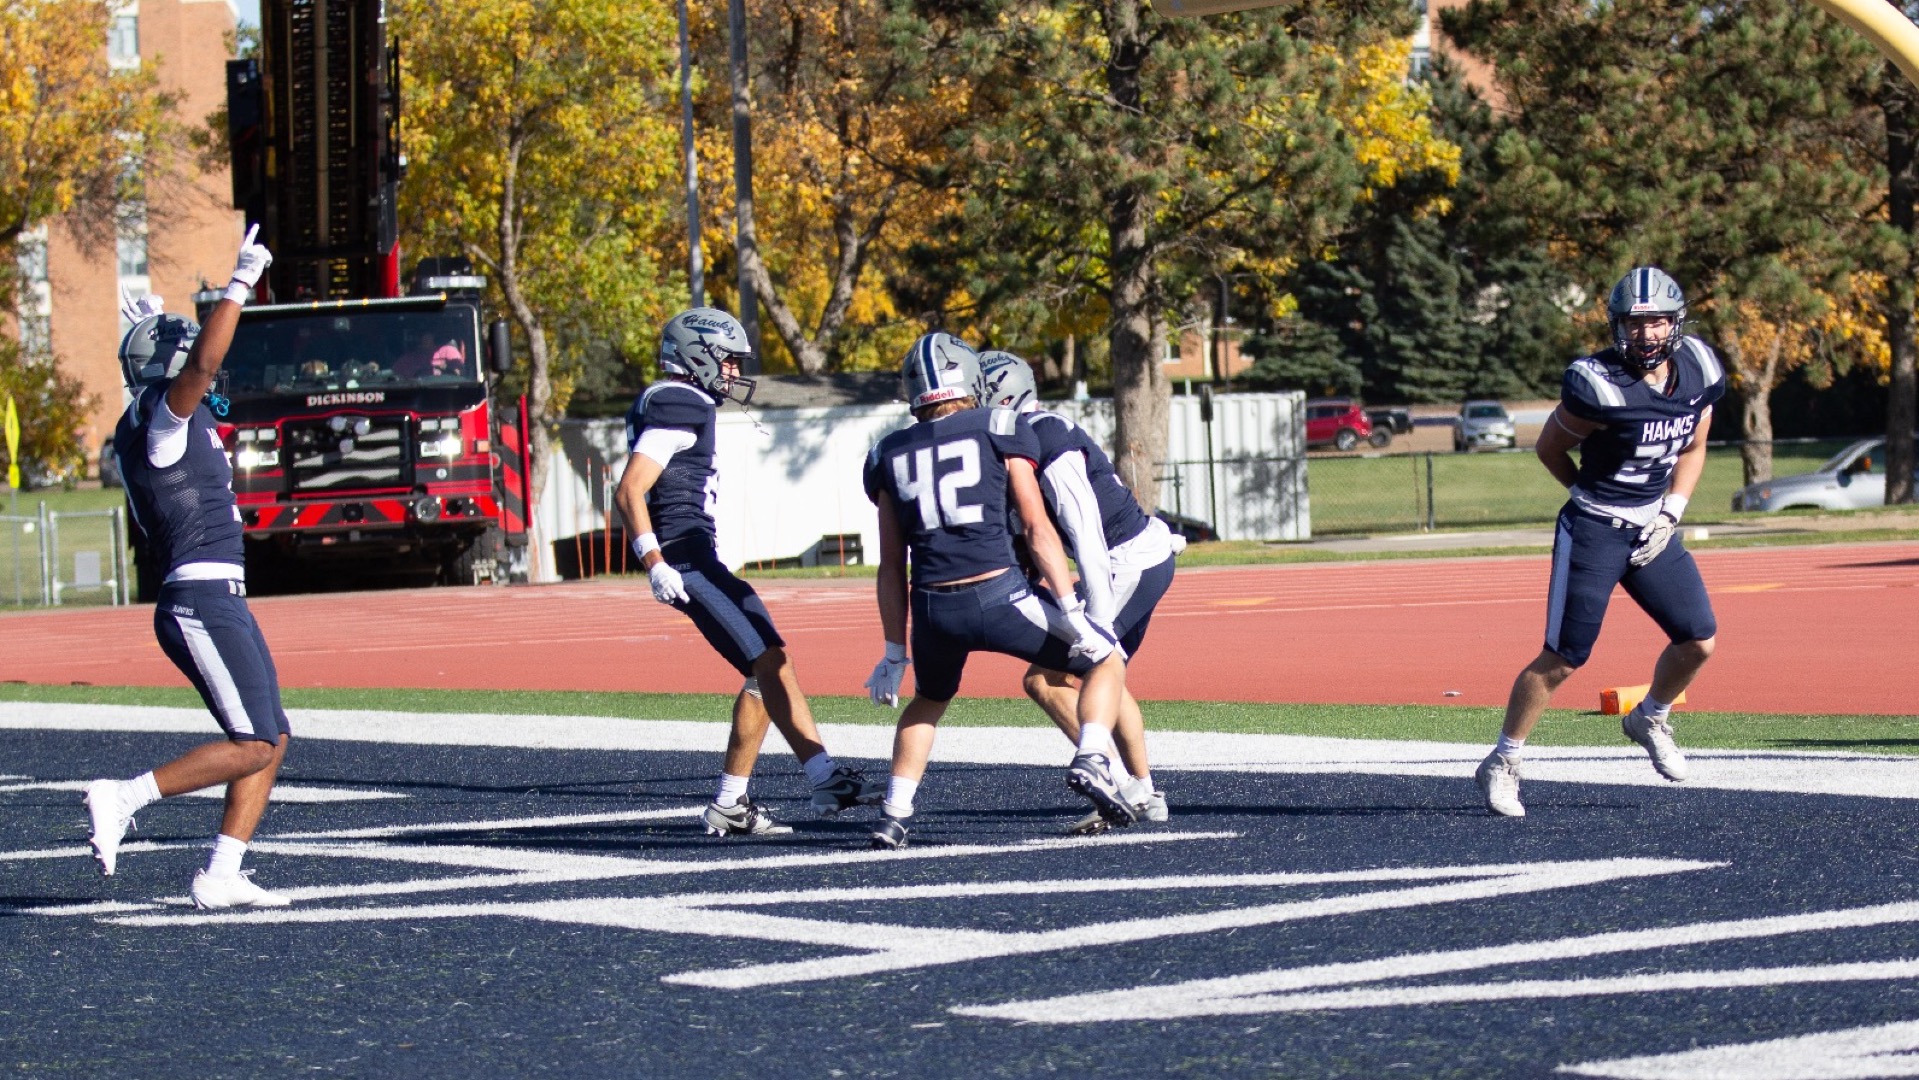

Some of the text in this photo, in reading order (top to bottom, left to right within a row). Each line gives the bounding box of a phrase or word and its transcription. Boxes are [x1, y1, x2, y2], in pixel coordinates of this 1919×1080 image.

[682, 314, 735, 337] Hawks
[307, 391, 385, 407] DICKINSON
[1641, 414, 1694, 443] HAWKS
[892, 438, 983, 530] 42
